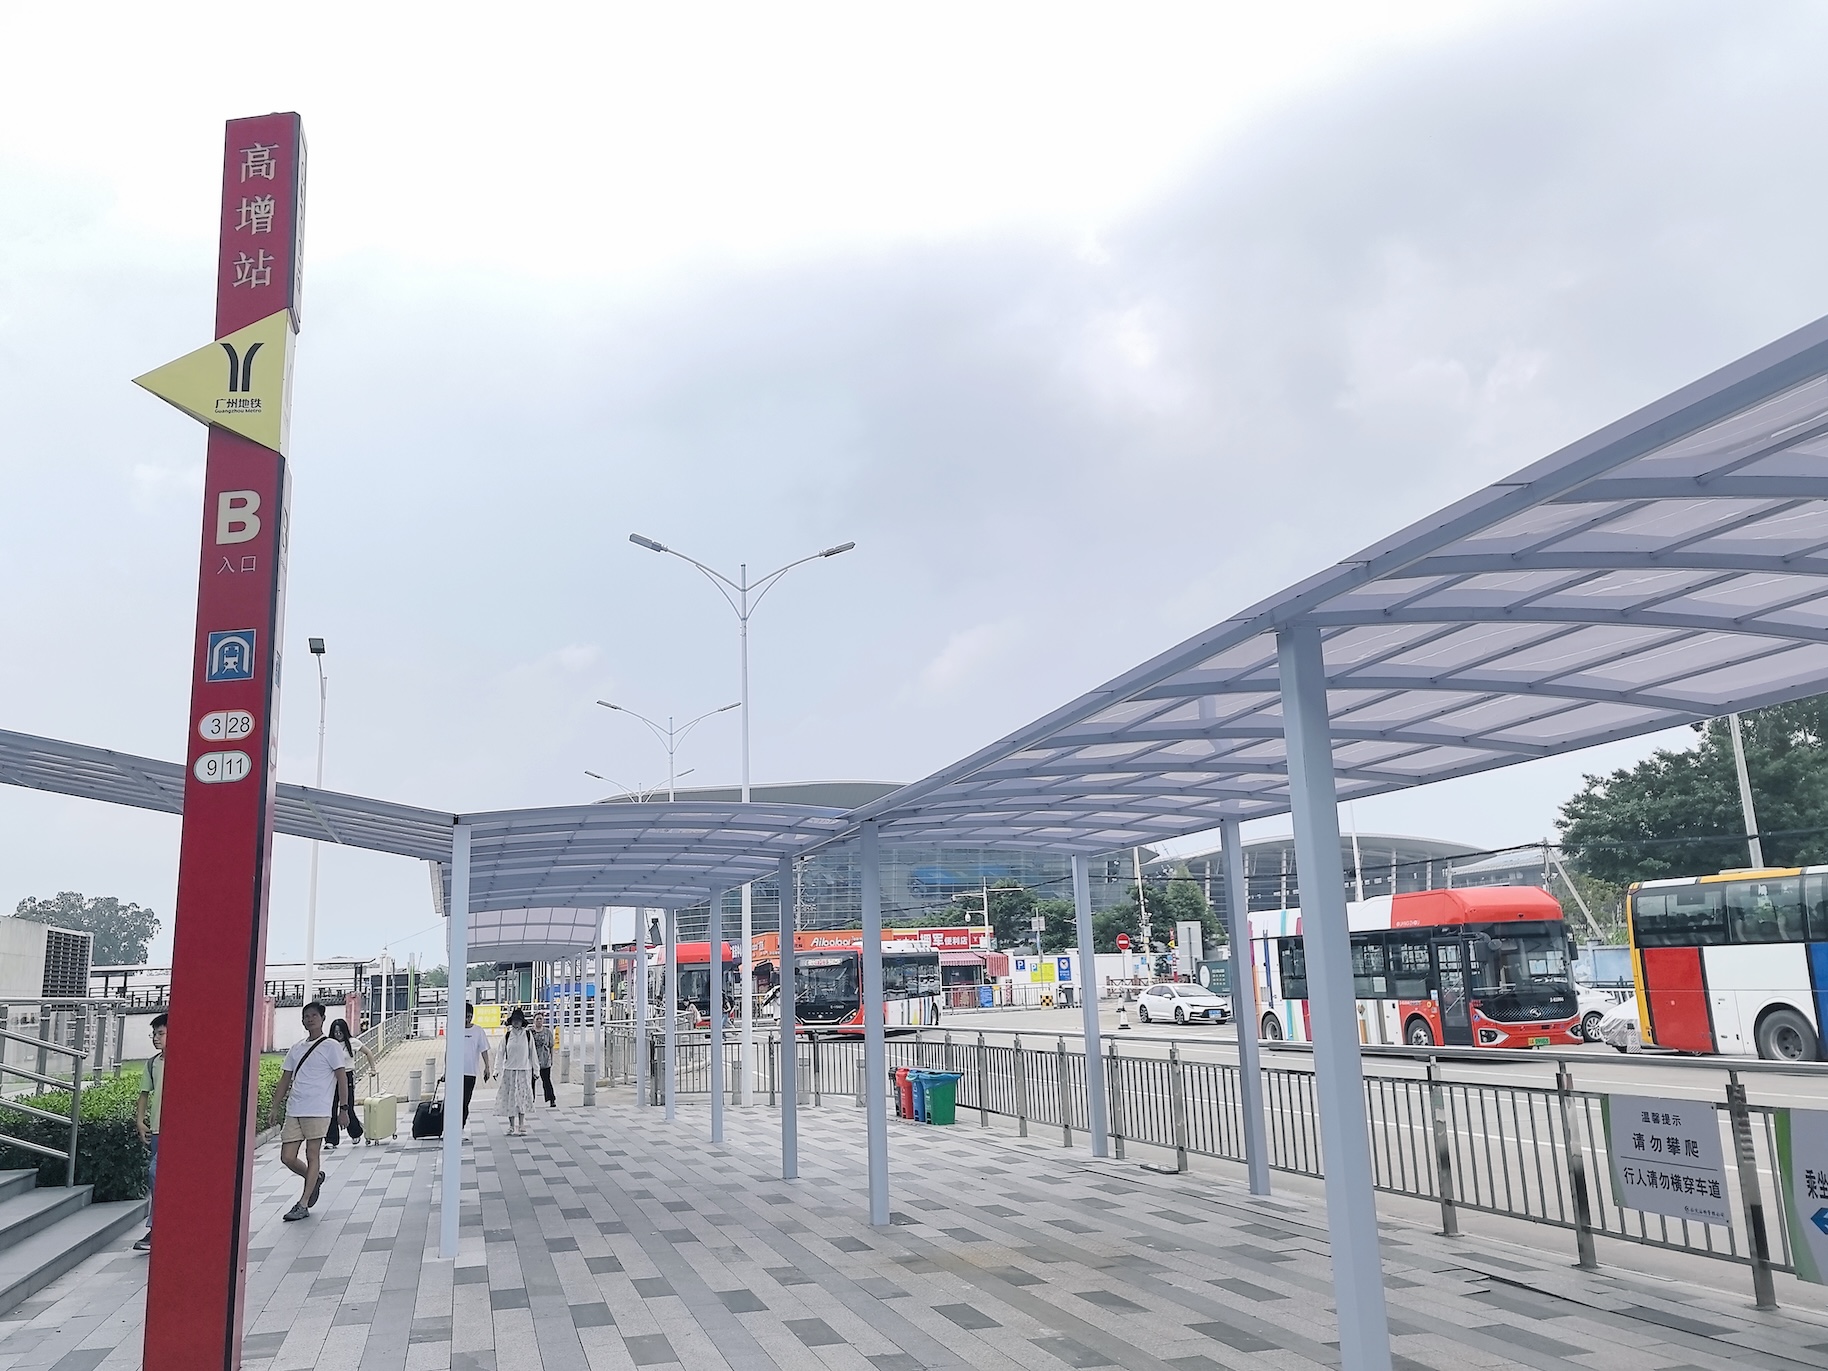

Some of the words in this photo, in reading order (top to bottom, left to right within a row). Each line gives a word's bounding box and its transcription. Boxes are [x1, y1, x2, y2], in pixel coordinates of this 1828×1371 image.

[232, 142, 279, 289] 高增站
[215, 398, 262, 409] 广州地铁
[215, 490, 261, 545] B
[217, 556, 257, 574] 入口
[211, 718, 221, 735] 3
[228, 716, 251, 734] 28
[206, 759, 217, 776] 9
[225, 758, 243, 775] 11
[1017, 961, 1024, 970] P
[1641, 1111, 1681, 1126] 温馨提示
[1632, 1132, 1699, 1158] 请勿攀爬
[1623, 1166, 1721, 1199] 行人请勿横穿车道
